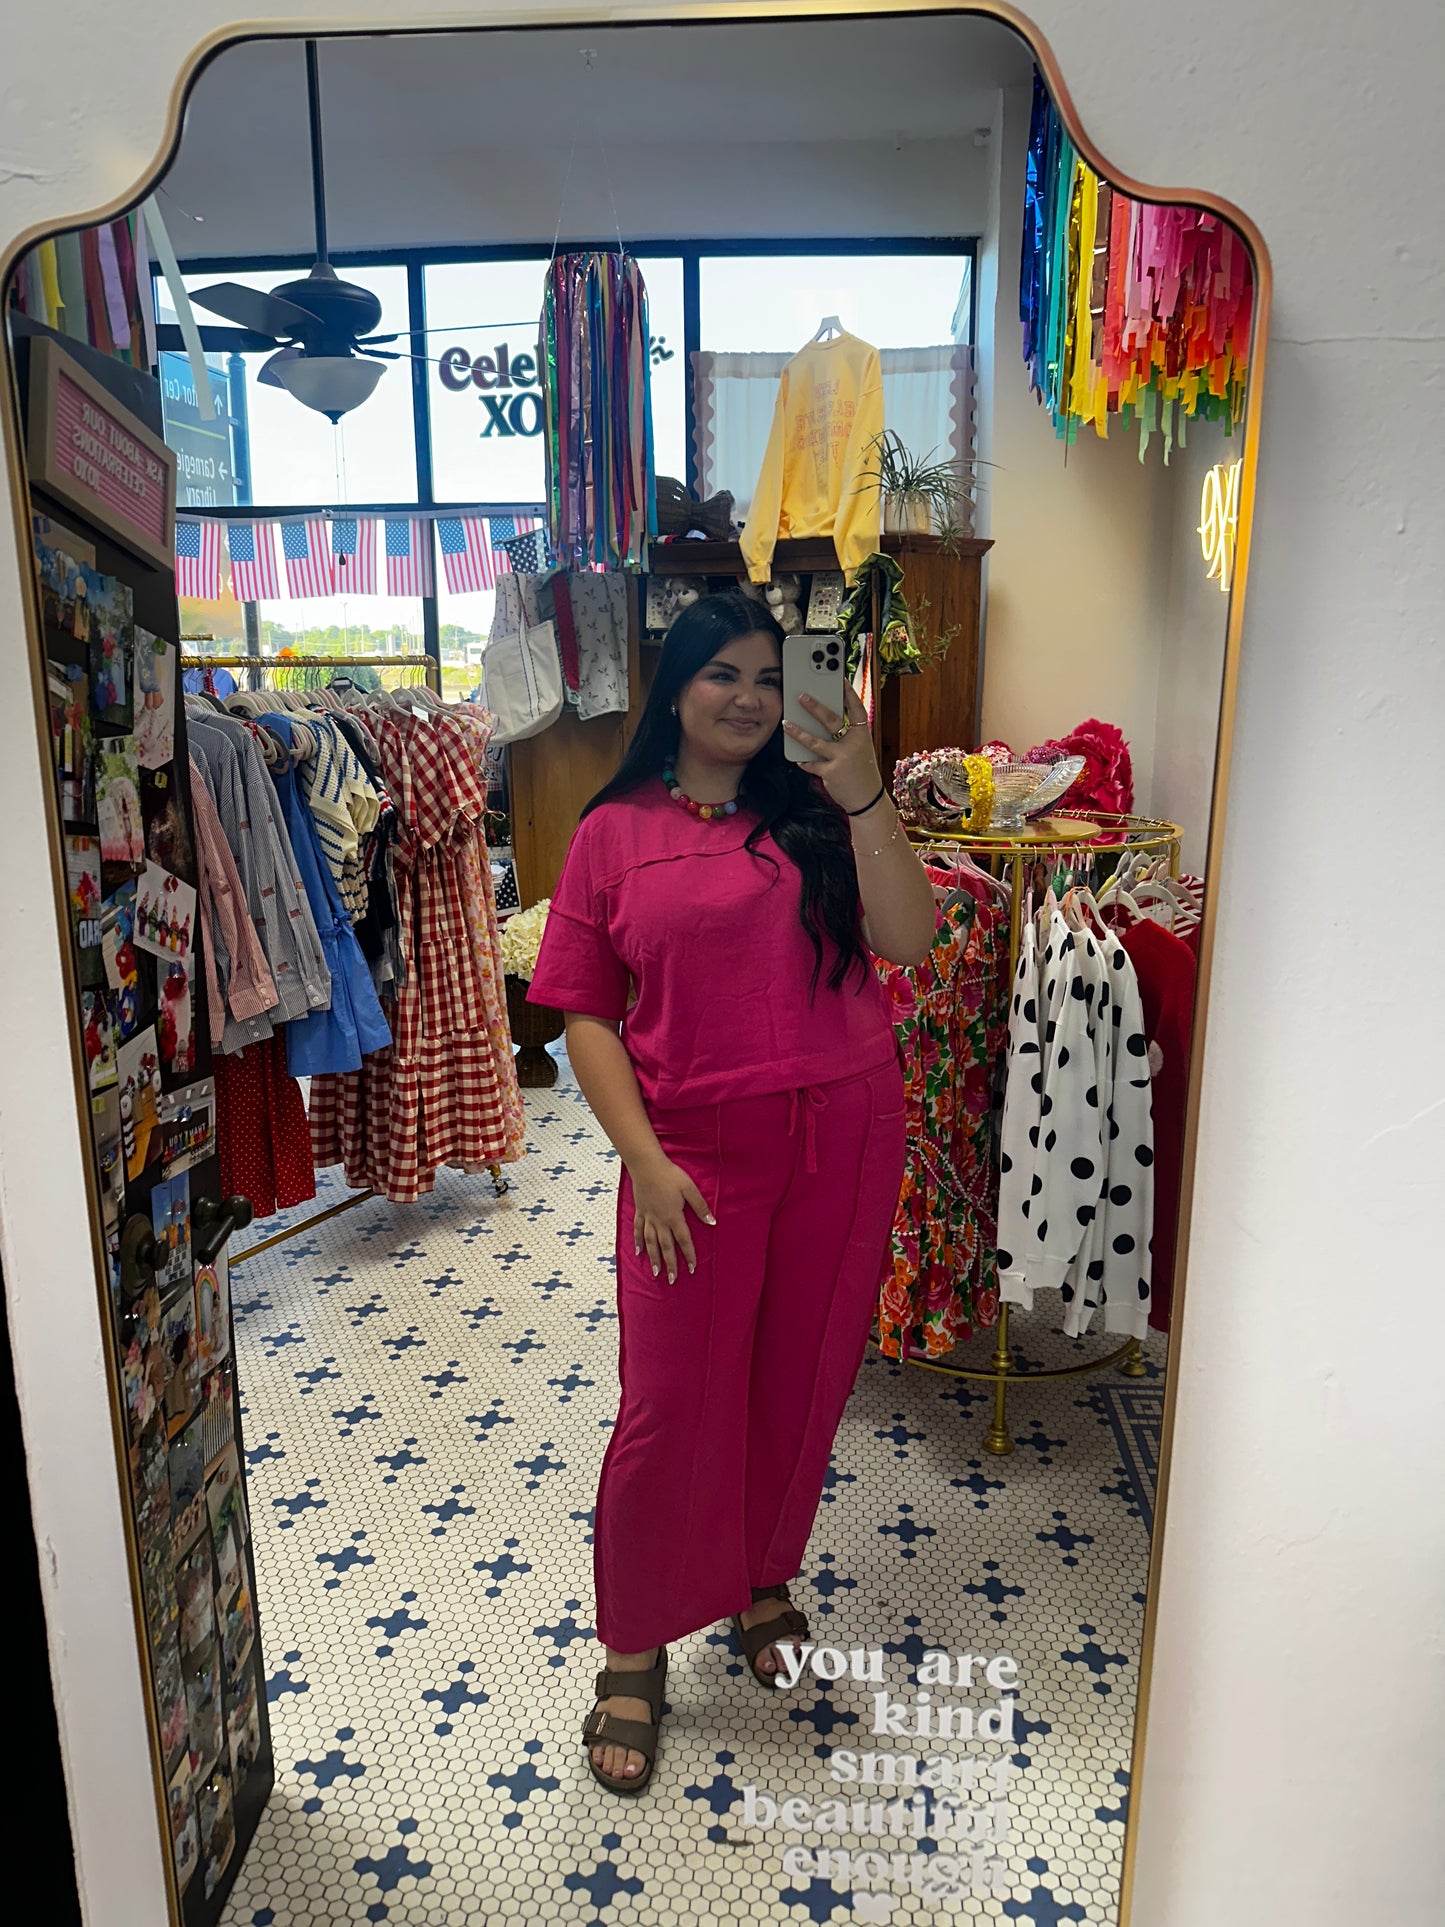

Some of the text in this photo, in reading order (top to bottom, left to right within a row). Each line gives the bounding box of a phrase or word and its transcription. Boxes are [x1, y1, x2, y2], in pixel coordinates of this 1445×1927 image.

[775, 1641, 1020, 1690] you are
[872, 1690, 1016, 1742] kind
[830, 1747, 1013, 1793] smart
[742, 1784, 1010, 1841] beautiful
[782, 1842, 1009, 1900] enough
